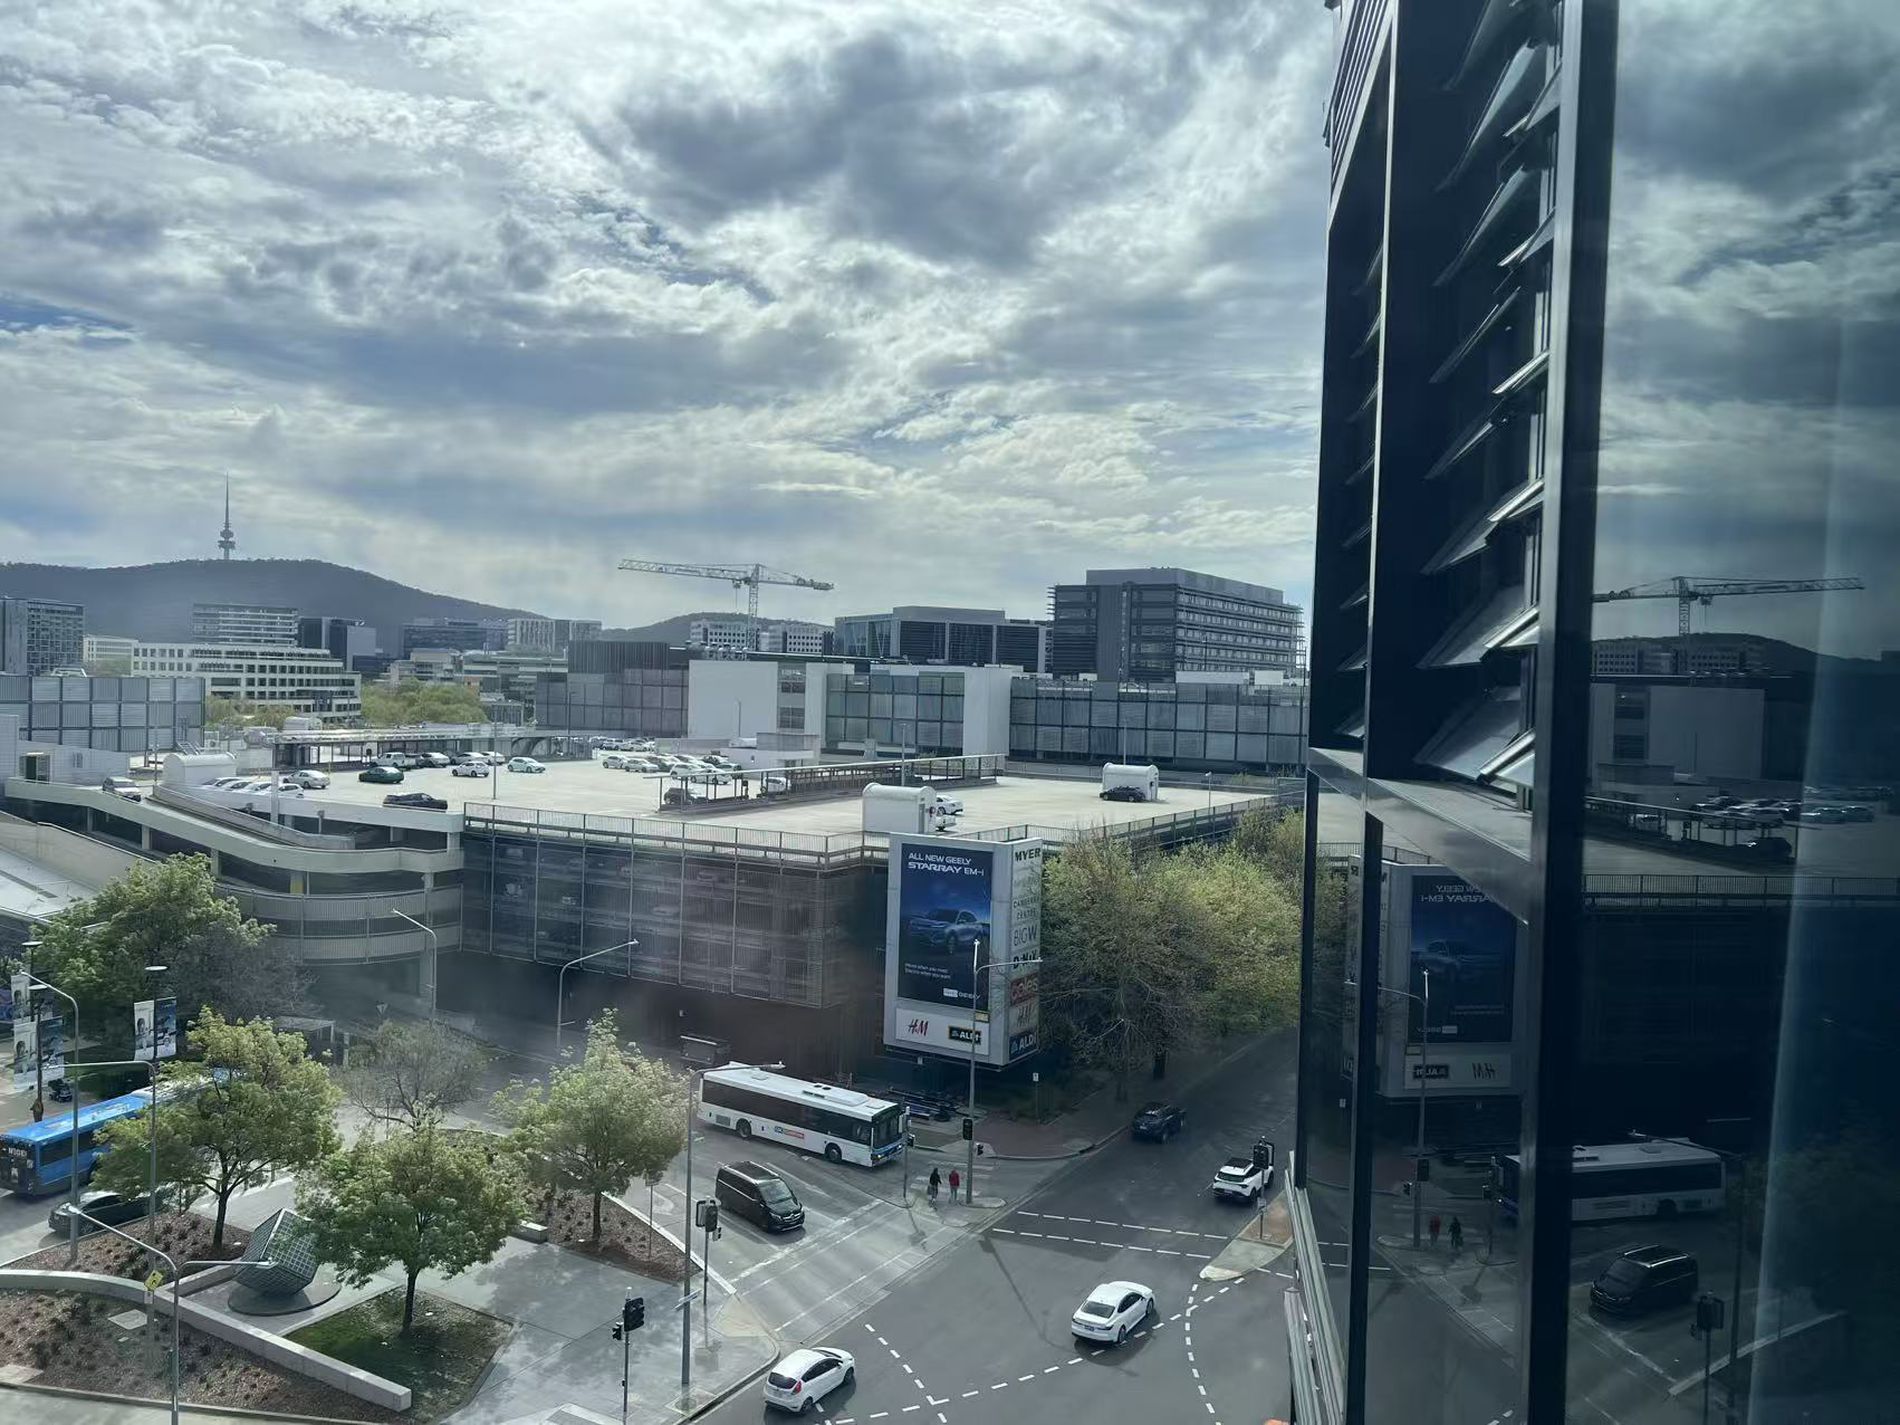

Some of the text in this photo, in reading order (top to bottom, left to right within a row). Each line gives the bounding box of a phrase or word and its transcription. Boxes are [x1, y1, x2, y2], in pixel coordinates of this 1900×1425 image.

[908, 852, 972, 866] ALL NEW GEELY
[1014, 847, 1041, 862] MYER
[907, 861, 962, 874] STARRAY
[907, 1018, 929, 1036] H&M
